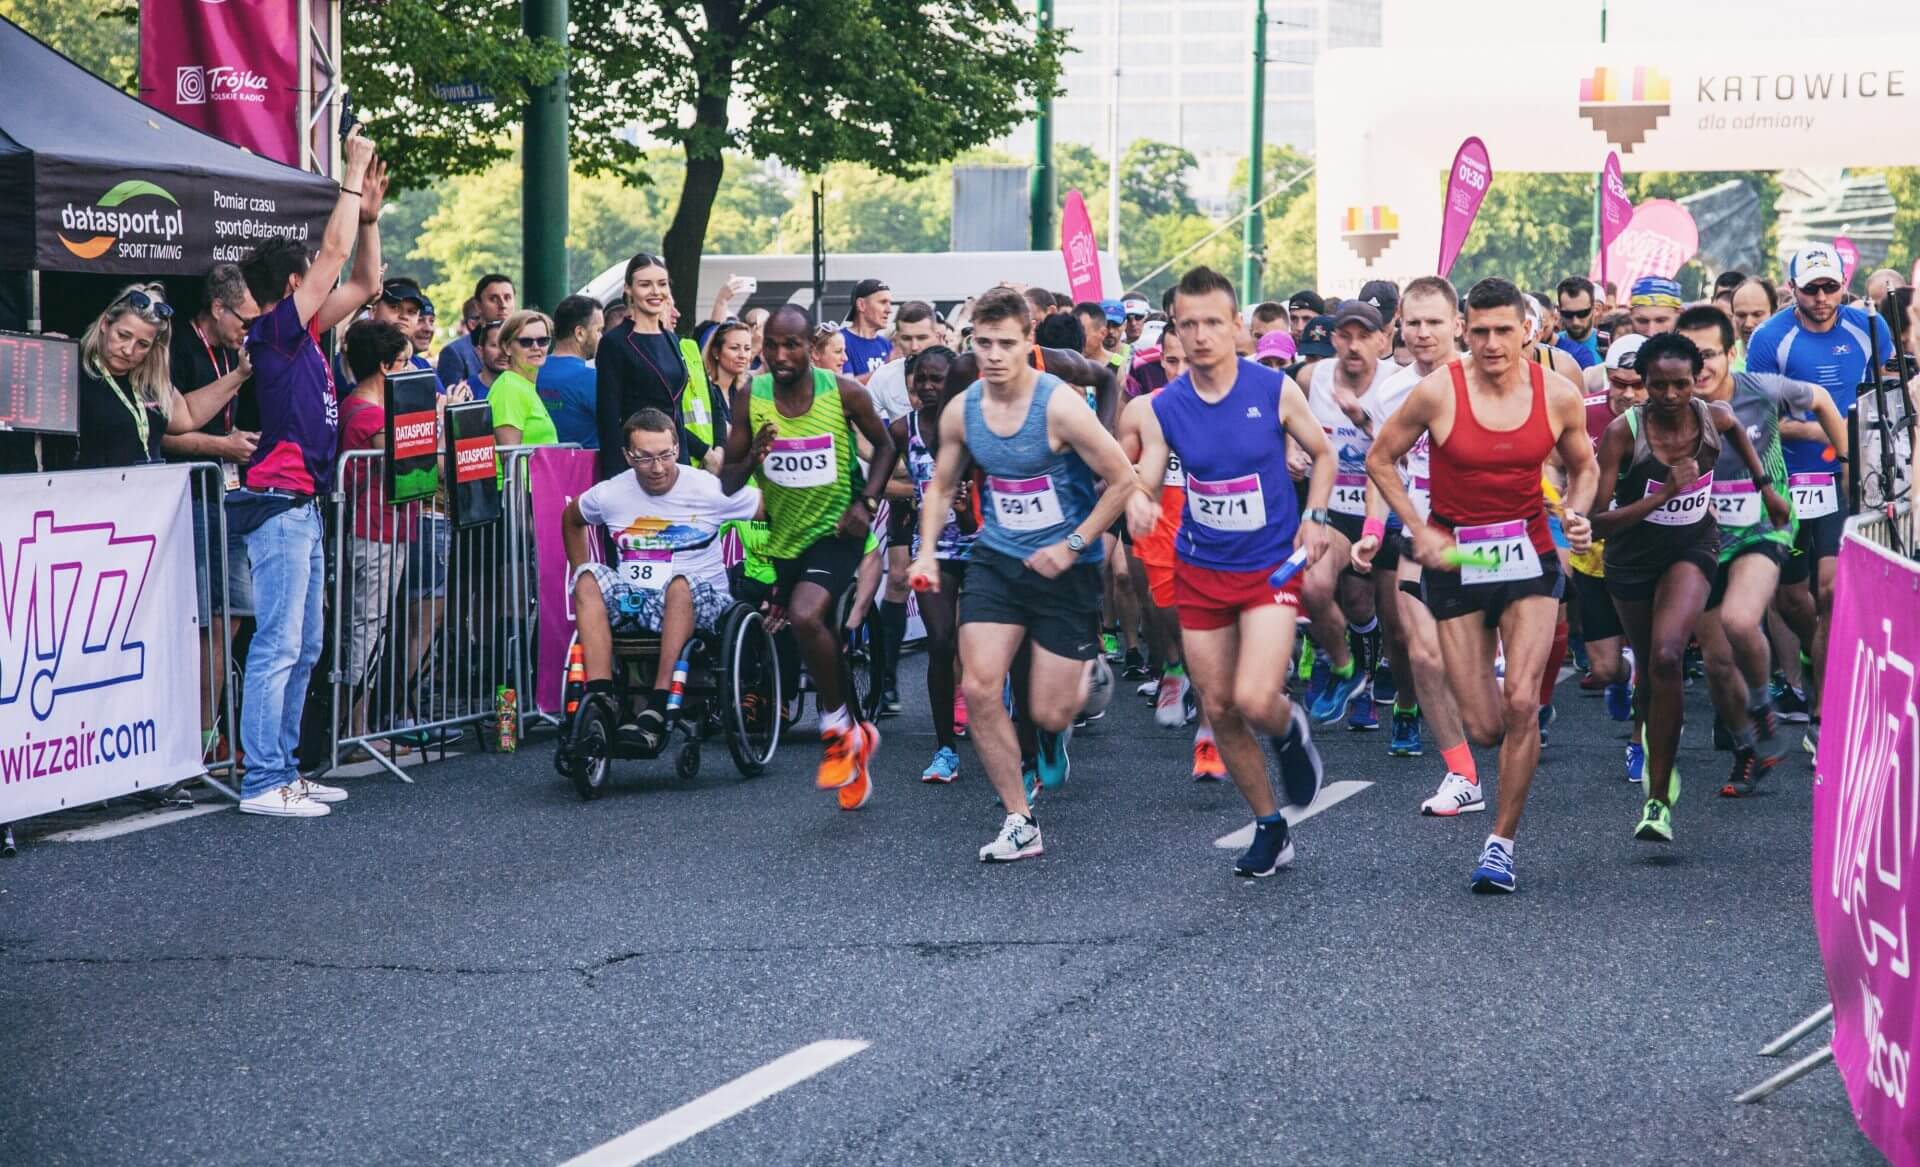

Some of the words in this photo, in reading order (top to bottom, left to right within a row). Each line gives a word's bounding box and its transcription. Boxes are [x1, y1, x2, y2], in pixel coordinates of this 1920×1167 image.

[207, 66, 268, 93] Trójka
[1698, 71, 1905, 102] KATOWICE
[239, 93, 265, 103] RADIO
[1698, 112, 1726, 129] dla
[1732, 111, 1815, 131] odmiany
[214, 190, 248, 210] Pomiar
[250, 198, 276, 212] czasu
[61, 202, 183, 241] datasport.pl
[118, 243, 147, 258] SPORT
[149, 244, 182, 260] TIMING
[395, 421, 435, 441] DATASPORT
[457, 446, 494, 465] DATASPORT
[771, 454, 827, 472] 2003
[1198, 498, 1248, 516] 27/1
[1657, 491, 1706, 513] 006
[630, 565, 652, 580] 38
[0, 720, 156, 784] wizzair.com
